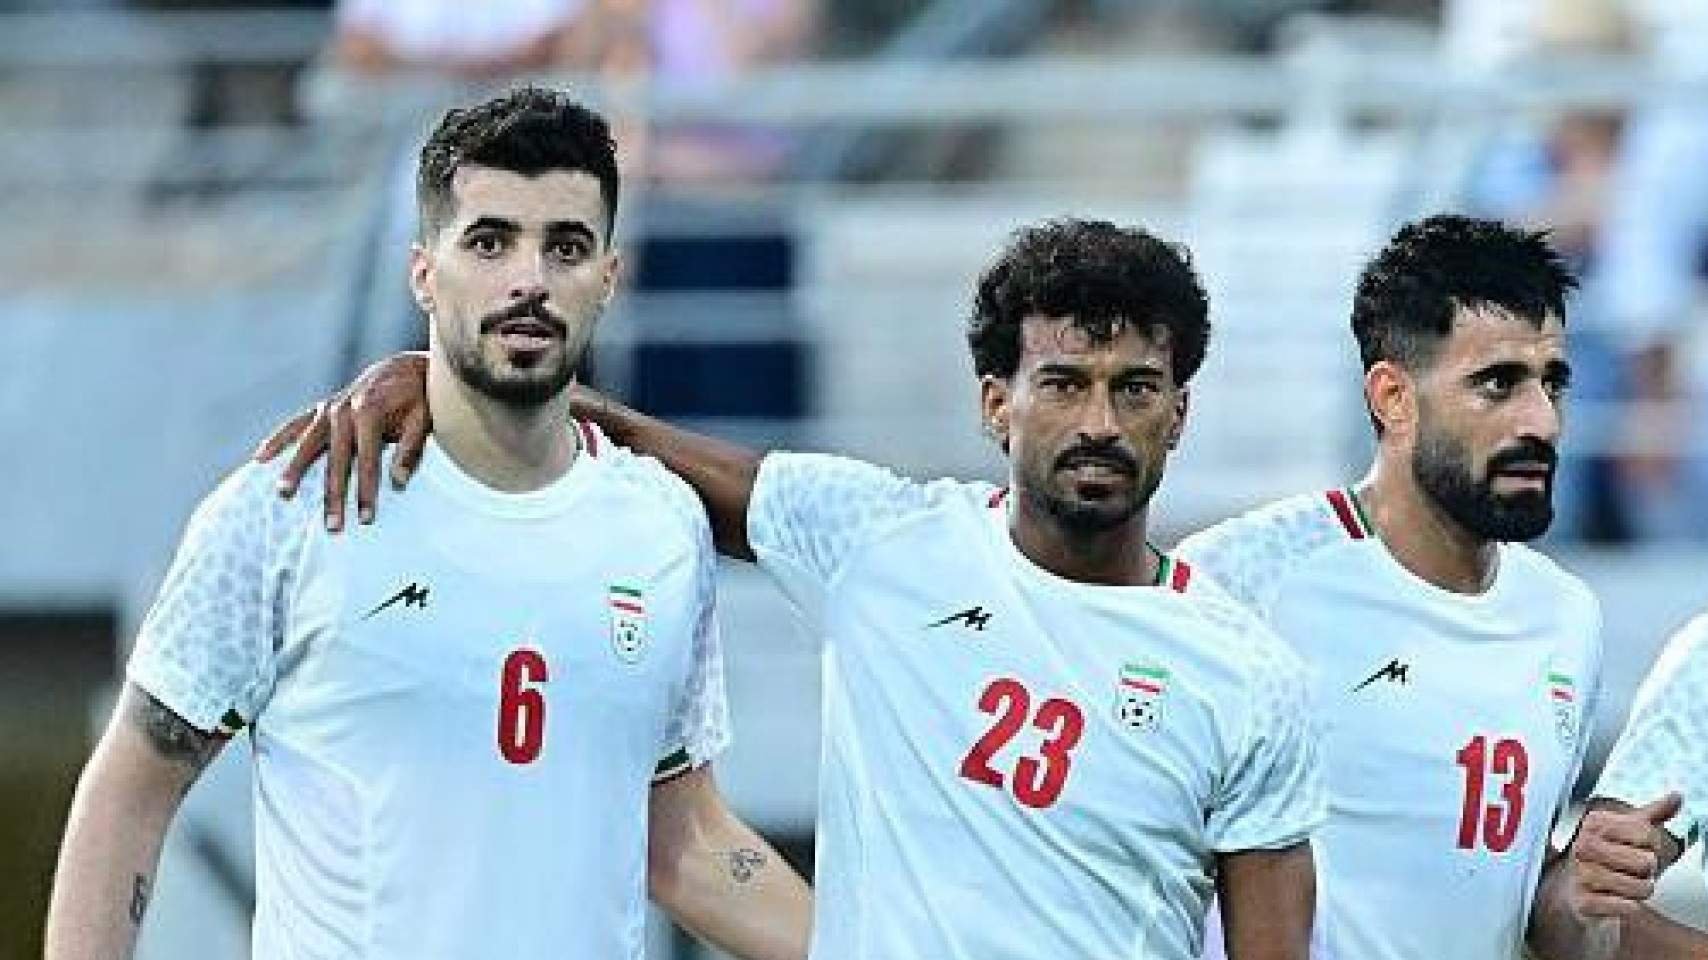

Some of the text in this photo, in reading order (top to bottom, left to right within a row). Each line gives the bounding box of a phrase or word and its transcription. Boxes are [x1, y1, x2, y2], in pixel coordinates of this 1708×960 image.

[498, 648, 549, 766] 6
[961, 678, 1086, 809] 23
[1457, 735, 1530, 854] 13
